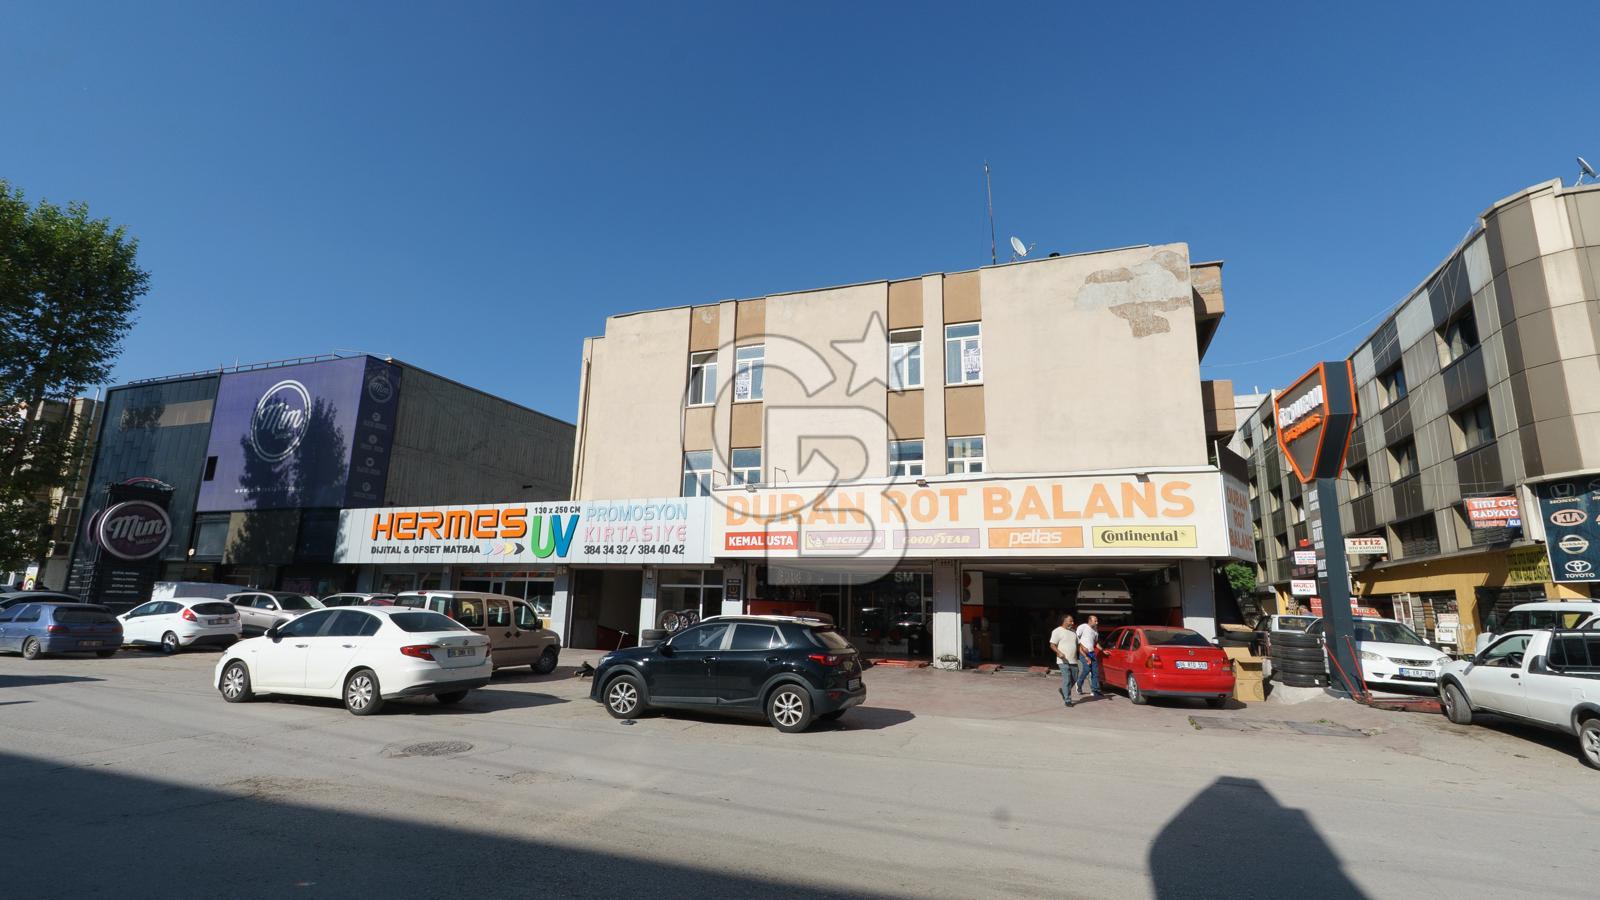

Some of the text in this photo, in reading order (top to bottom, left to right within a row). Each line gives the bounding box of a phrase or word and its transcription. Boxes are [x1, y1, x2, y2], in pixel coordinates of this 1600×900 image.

[725, 481, 1196, 527] DURAN ROT BALANS
[585, 503, 688, 522] PROMOSYON
[1555, 512, 1583, 523] KIA
[107, 514, 166, 542] Mim
[530, 514, 580, 558] UV
[728, 535, 794, 546] KEMAL USTA
[1101, 530, 1179, 544] Continental
[412, 545, 442, 554] OFSET
[443, 545, 480, 554] MATBAA
[584, 545, 600, 554] 384
[602, 545, 614, 554] 34
[616, 545, 628, 554] 32
[638, 545, 656, 554] 384
[658, 545, 670, 554] 40
[672, 545, 685, 554] 42
